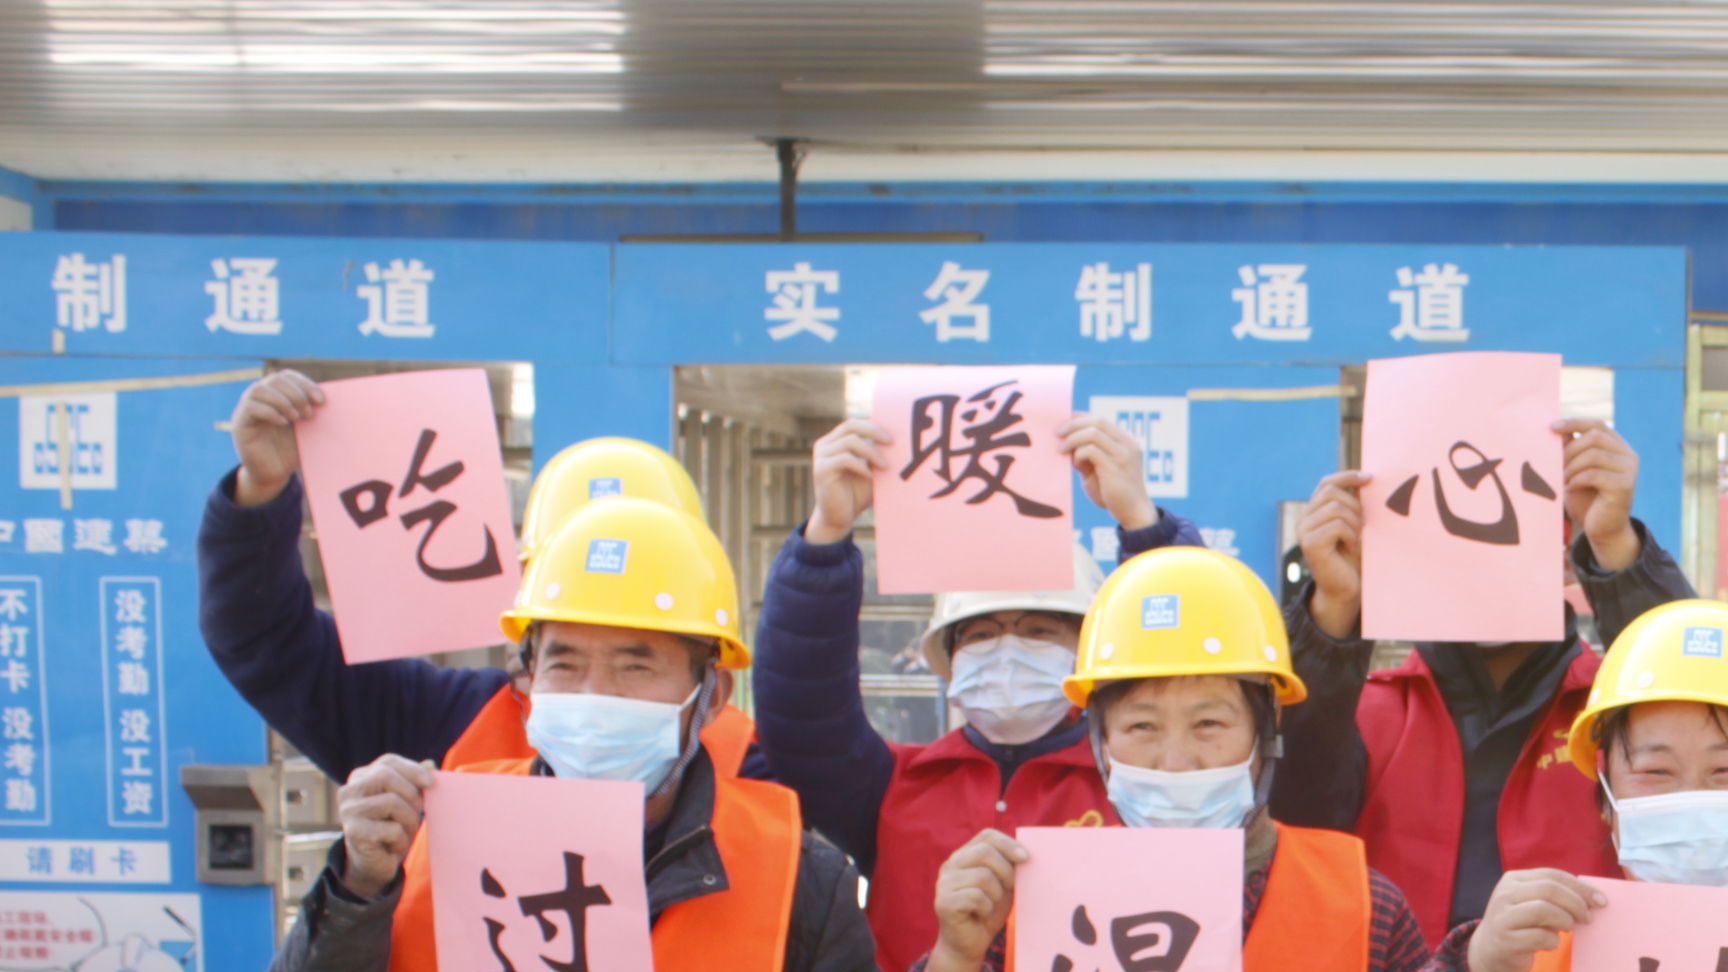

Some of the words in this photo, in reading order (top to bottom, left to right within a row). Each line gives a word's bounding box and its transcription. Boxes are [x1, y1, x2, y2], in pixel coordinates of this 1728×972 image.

[51, 253, 436, 338] 制通道
[764, 261, 1470, 342] 实名制通道
[900, 379, 1065, 519] 暖
[1384, 440, 1557, 546] 心
[338, 428, 503, 583] 吃
[26, 846, 137, 877] 请刷卡
